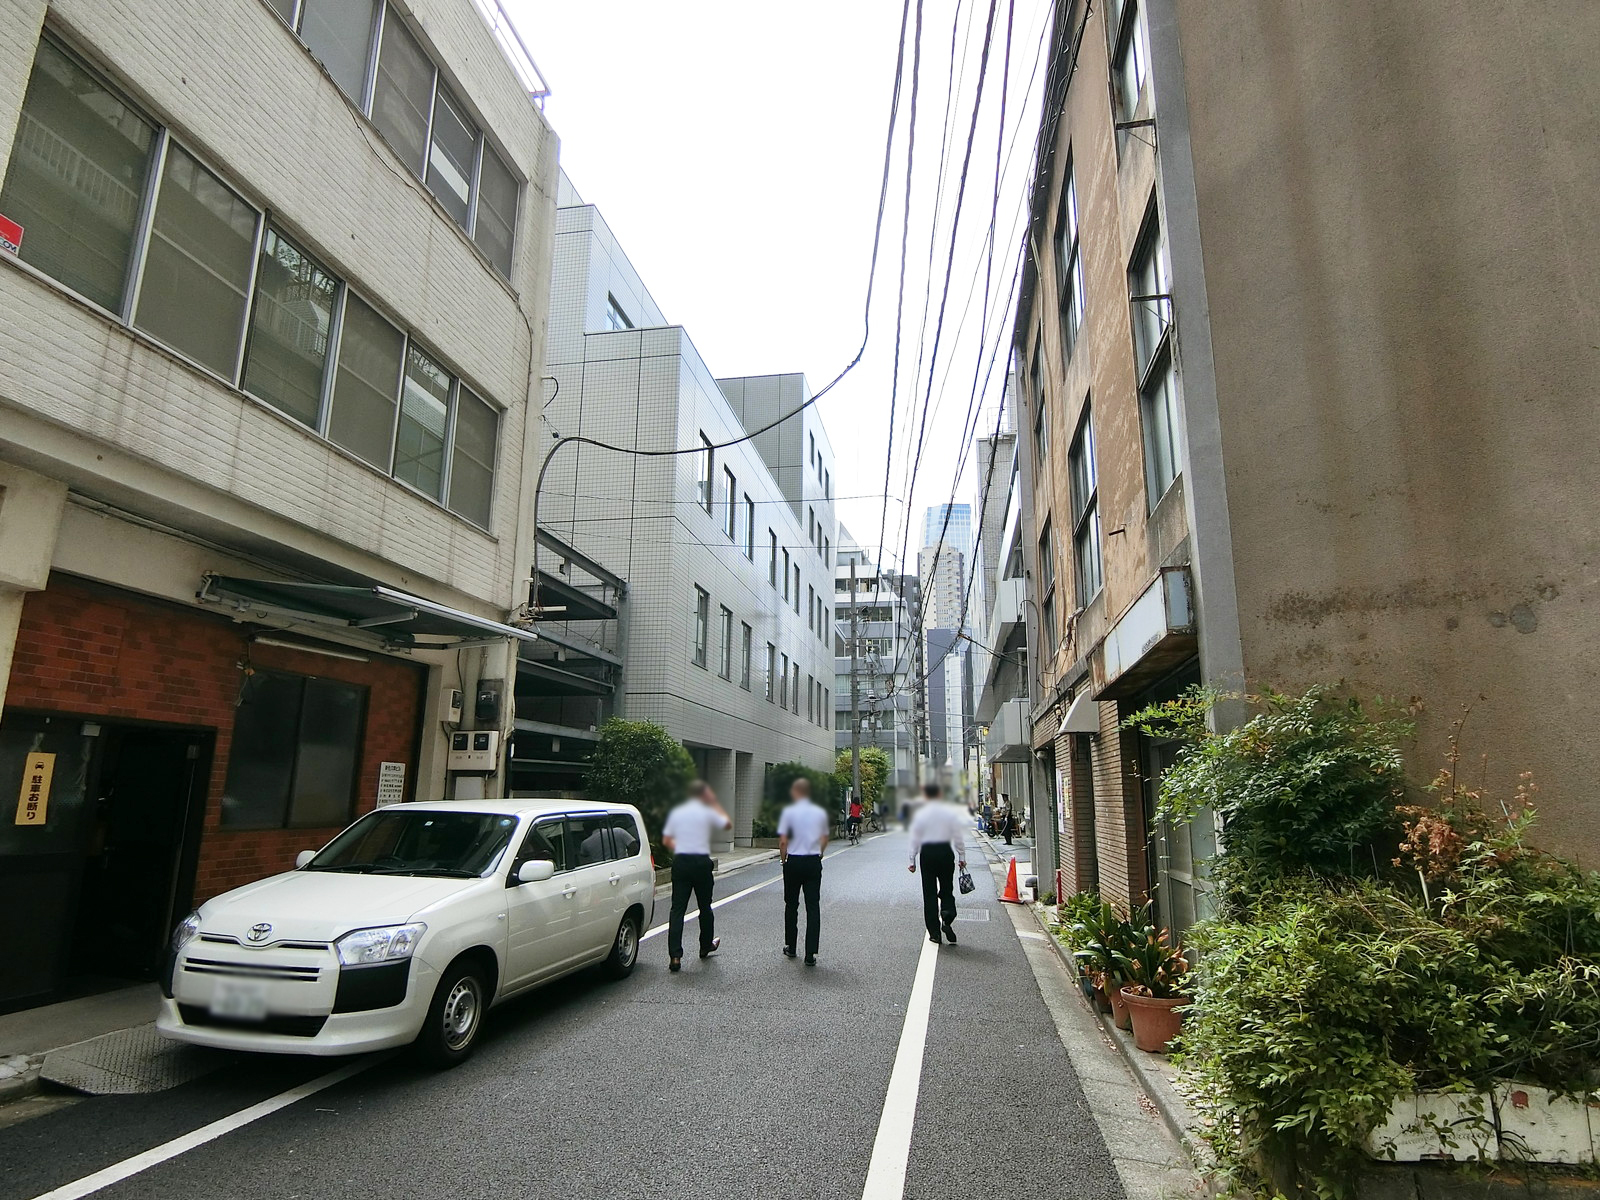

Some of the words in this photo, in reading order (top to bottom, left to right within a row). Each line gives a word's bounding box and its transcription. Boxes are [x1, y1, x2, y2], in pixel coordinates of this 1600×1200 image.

[26, 775, 43, 820] 駐車お断り
